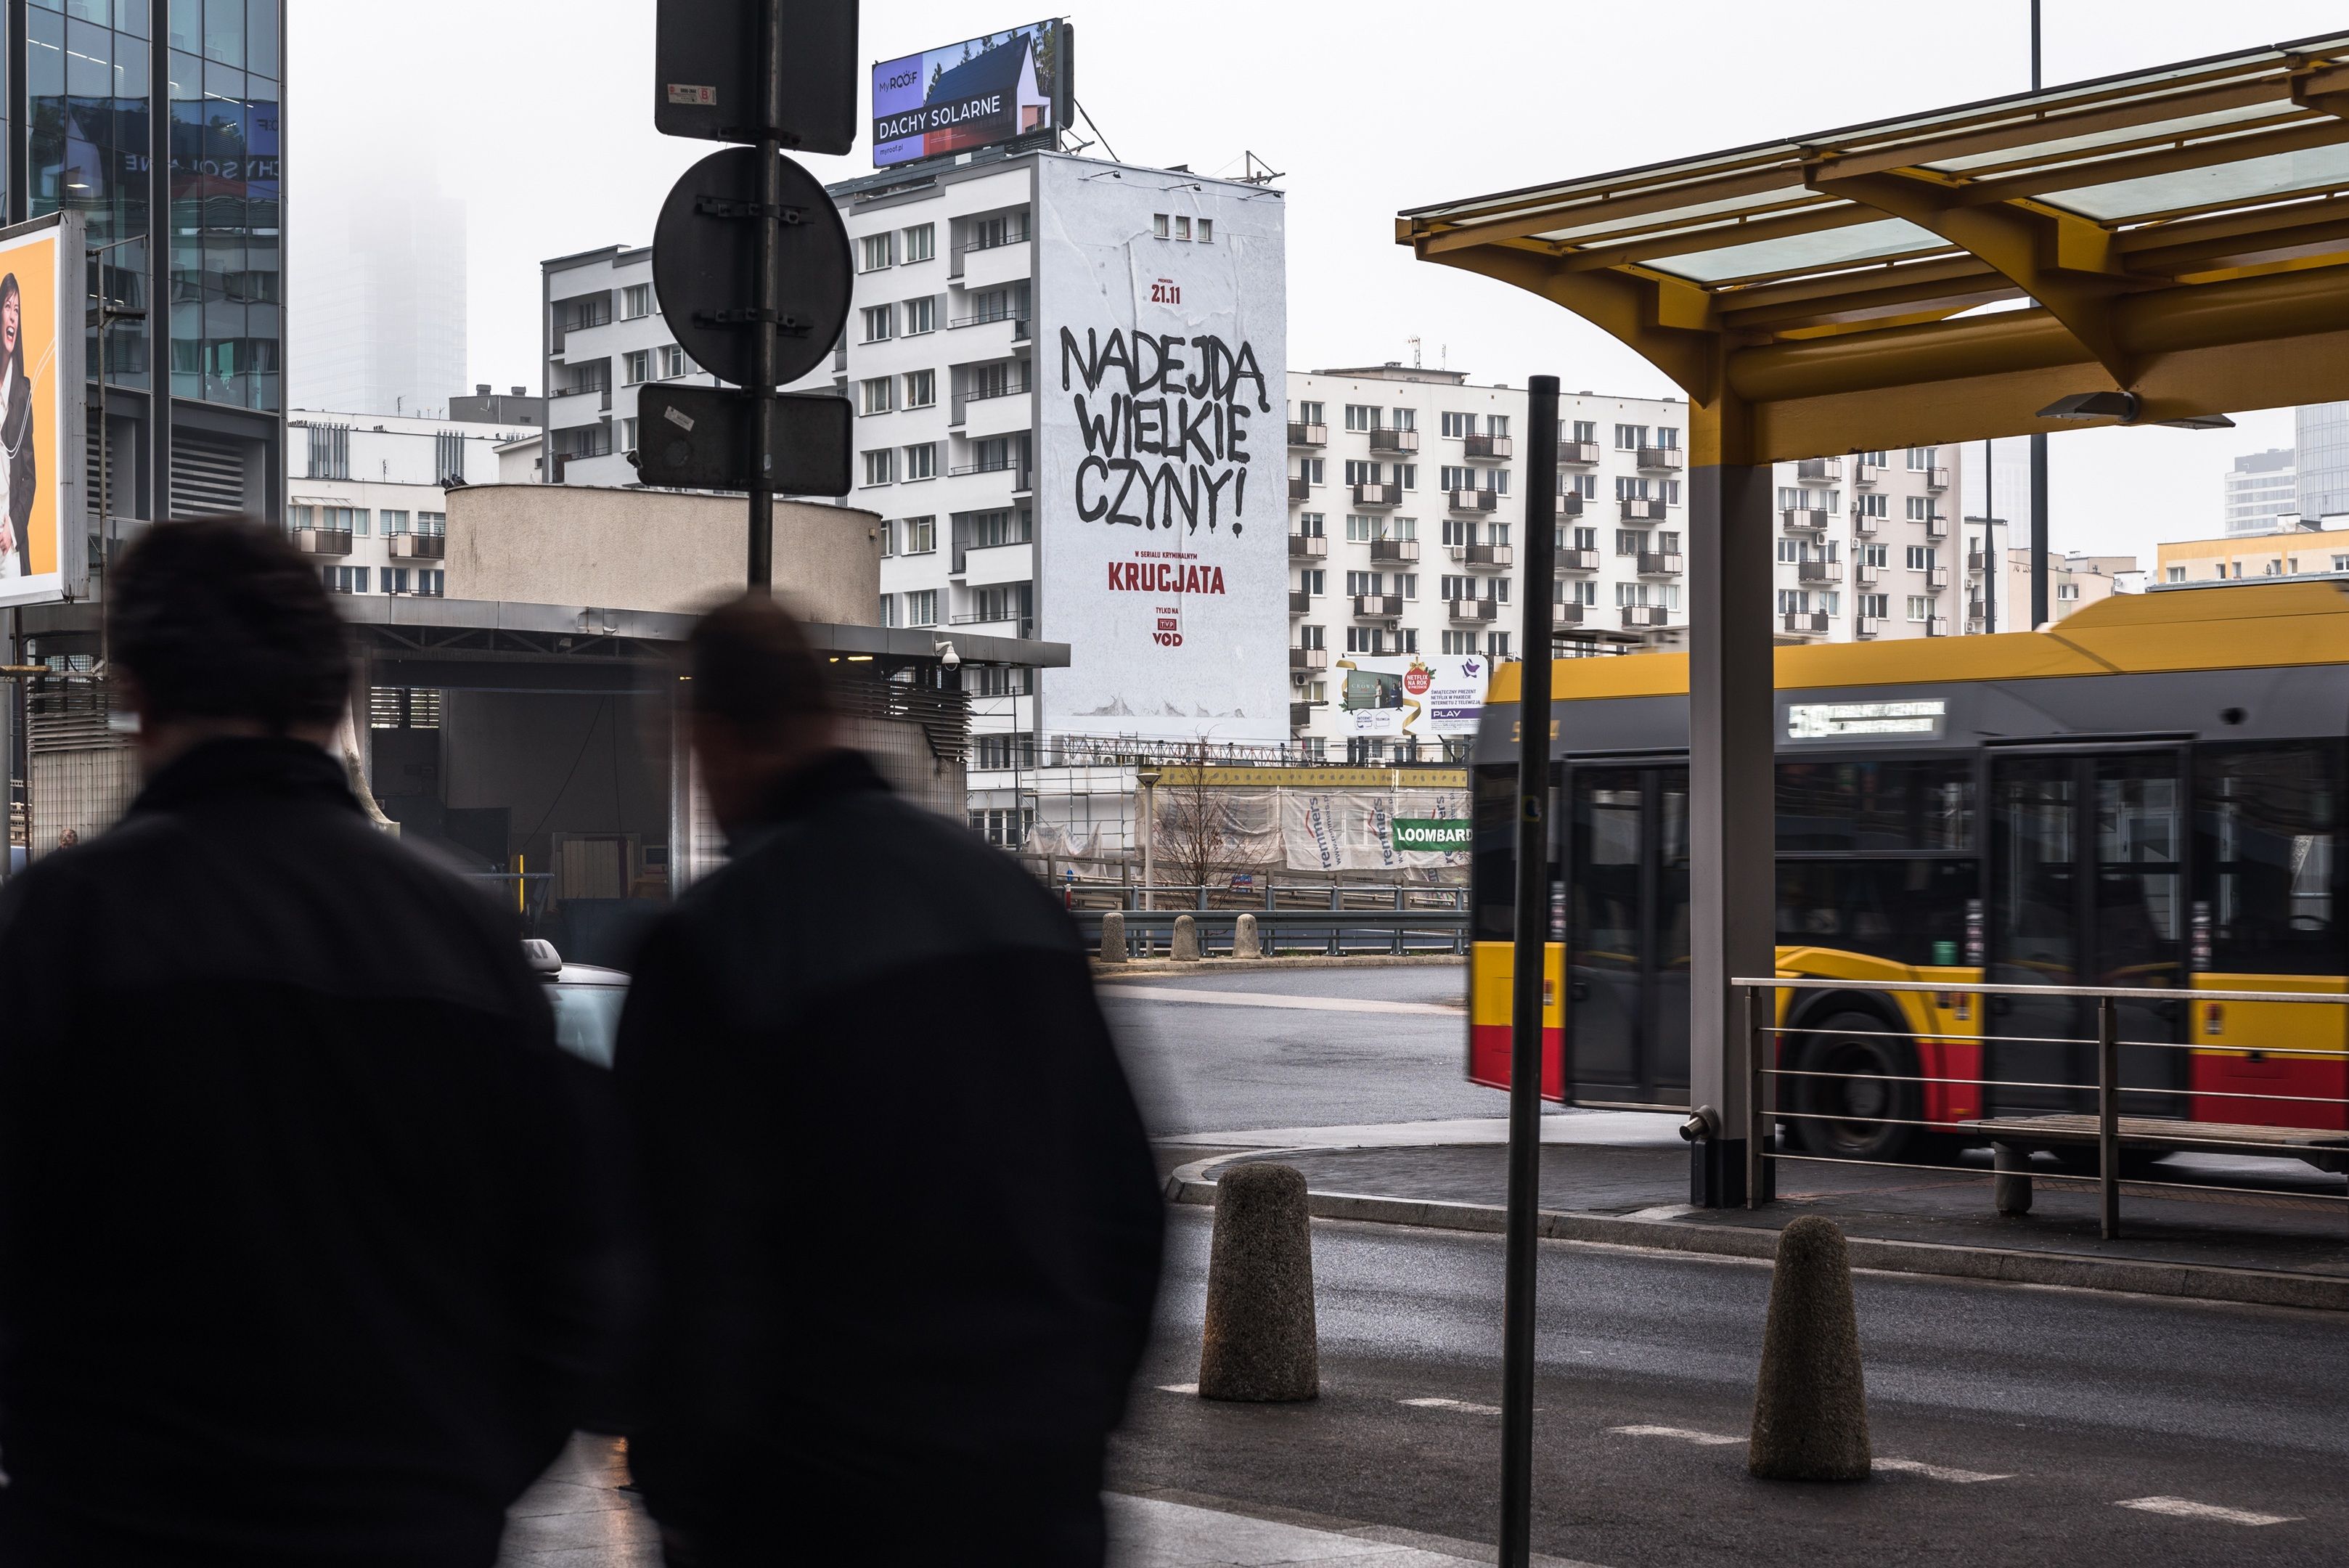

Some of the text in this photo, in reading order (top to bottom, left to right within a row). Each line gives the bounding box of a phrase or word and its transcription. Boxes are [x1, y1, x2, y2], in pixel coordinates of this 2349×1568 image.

[879, 95, 1000, 139] DACHY SOLARNE
[880, 144, 904, 157] myroof.pl
[1151, 284, 1180, 304] 21.11
[1061, 326, 1270, 413] NADEJDA
[1074, 392, 1251, 466] WIELKIE
[1075, 455, 1247, 538] CZYNY!
[1108, 562, 1226, 595] KRUCJATA
[1153, 632, 1183, 647] VOD
[1310, 797, 1331, 868] remmers
[1374, 798, 1393, 865] remmers
[1397, 828, 1474, 842] LOOMBARD
